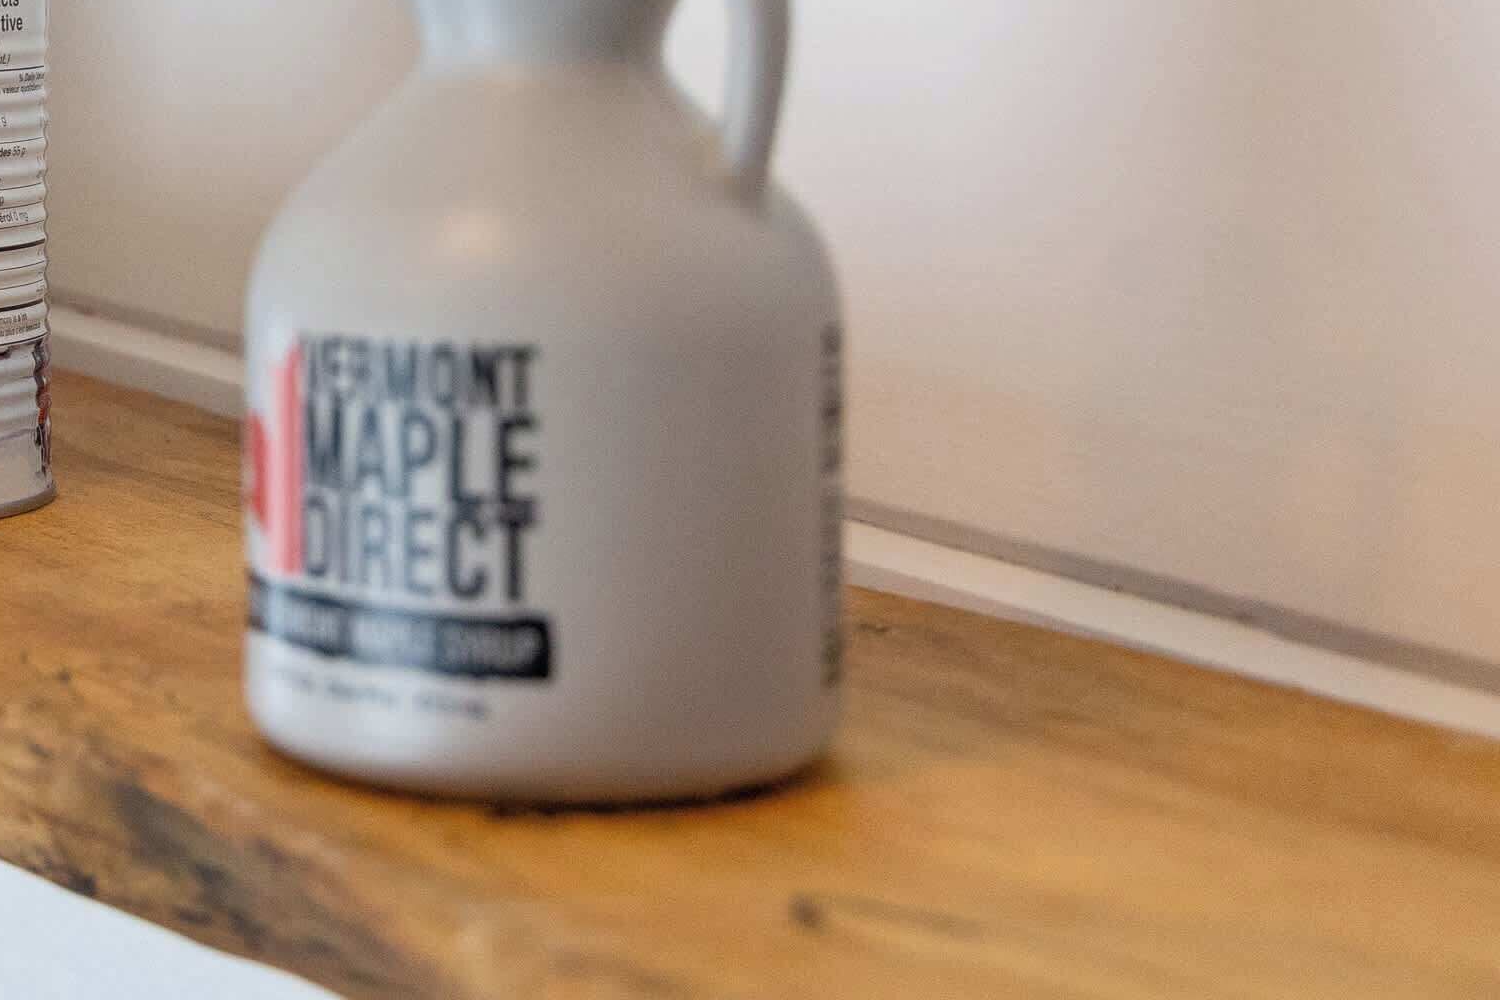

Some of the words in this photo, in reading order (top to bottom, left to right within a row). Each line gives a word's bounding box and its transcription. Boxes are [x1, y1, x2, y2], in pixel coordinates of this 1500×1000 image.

[300, 336, 538, 406] VERMONT
[301, 396, 538, 501] MAPLE
[301, 491, 537, 602] DIRECT
